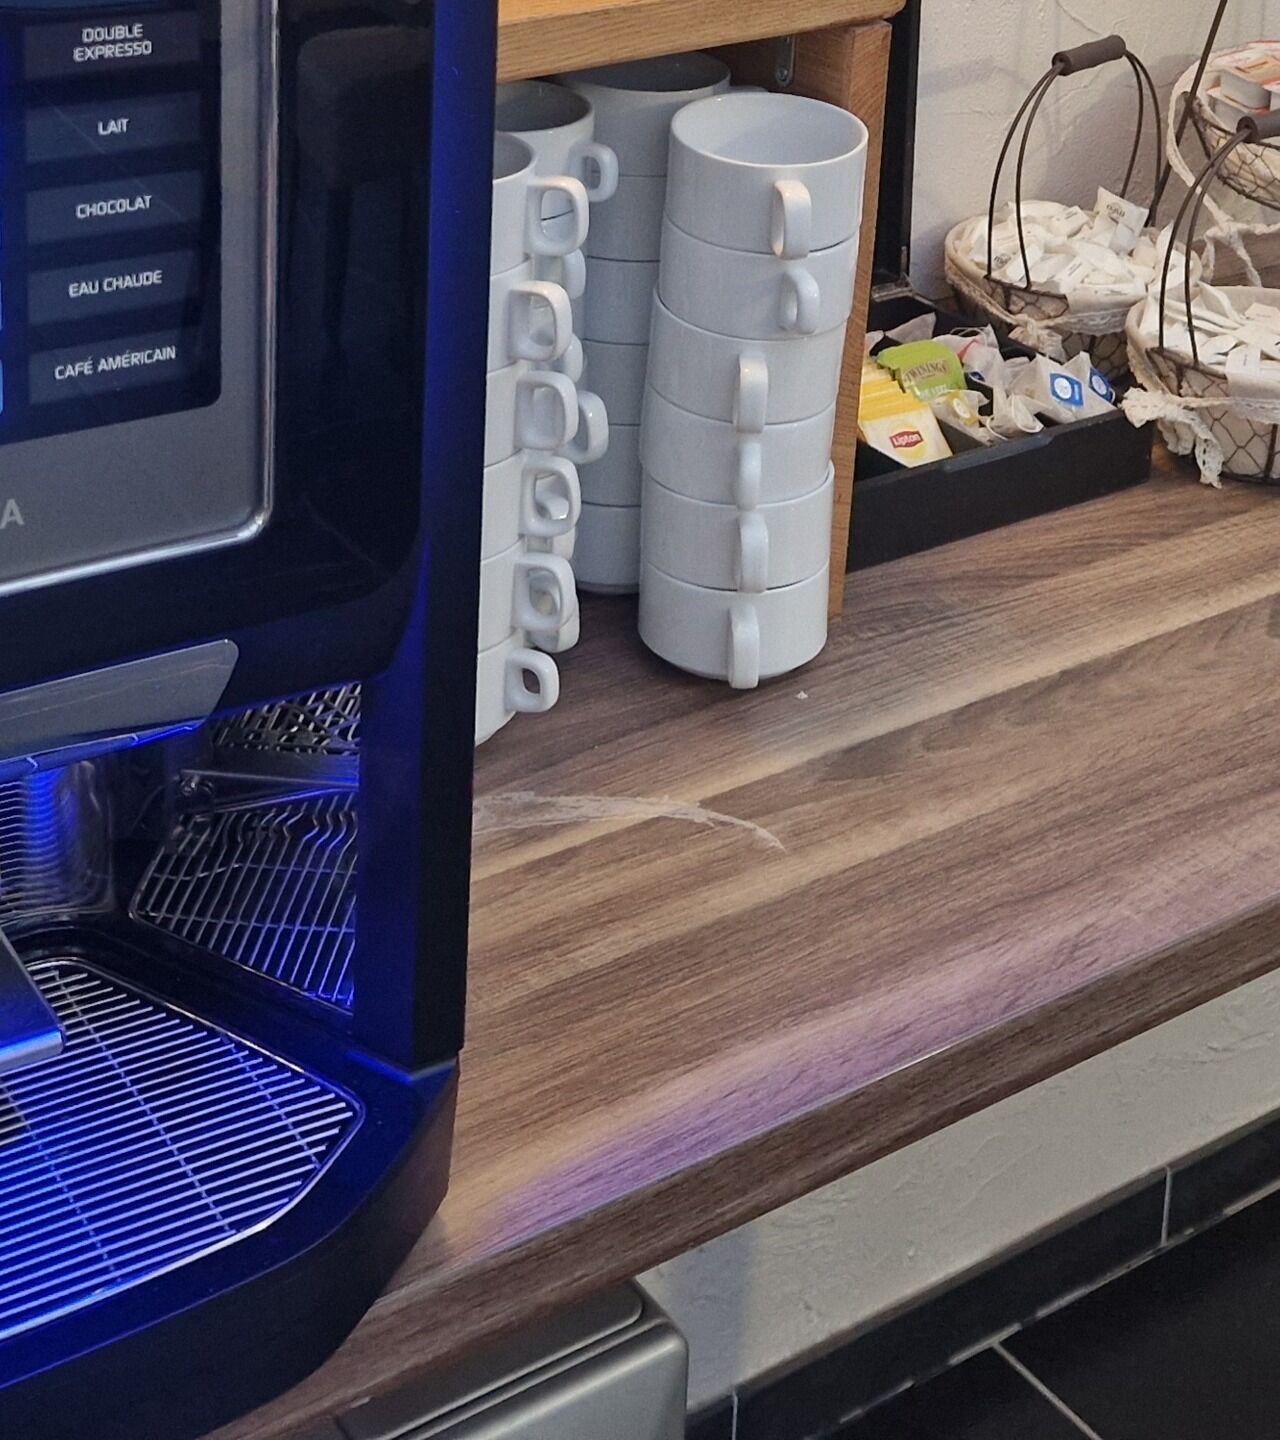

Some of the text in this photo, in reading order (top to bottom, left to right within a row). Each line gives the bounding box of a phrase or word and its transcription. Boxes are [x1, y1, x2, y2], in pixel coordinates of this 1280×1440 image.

[82, 23, 143, 43] DOUBLE
[73, 41, 152, 62] EXPRESSO
[97, 118, 129, 135] LAIT
[75, 194, 152, 219] CHOCOLAT
[68, 270, 162, 298] EAU CHAUDE
[54, 345, 176, 380] CAFÉ AMÉRICAIN
[891, 433, 922, 447] Lipton
